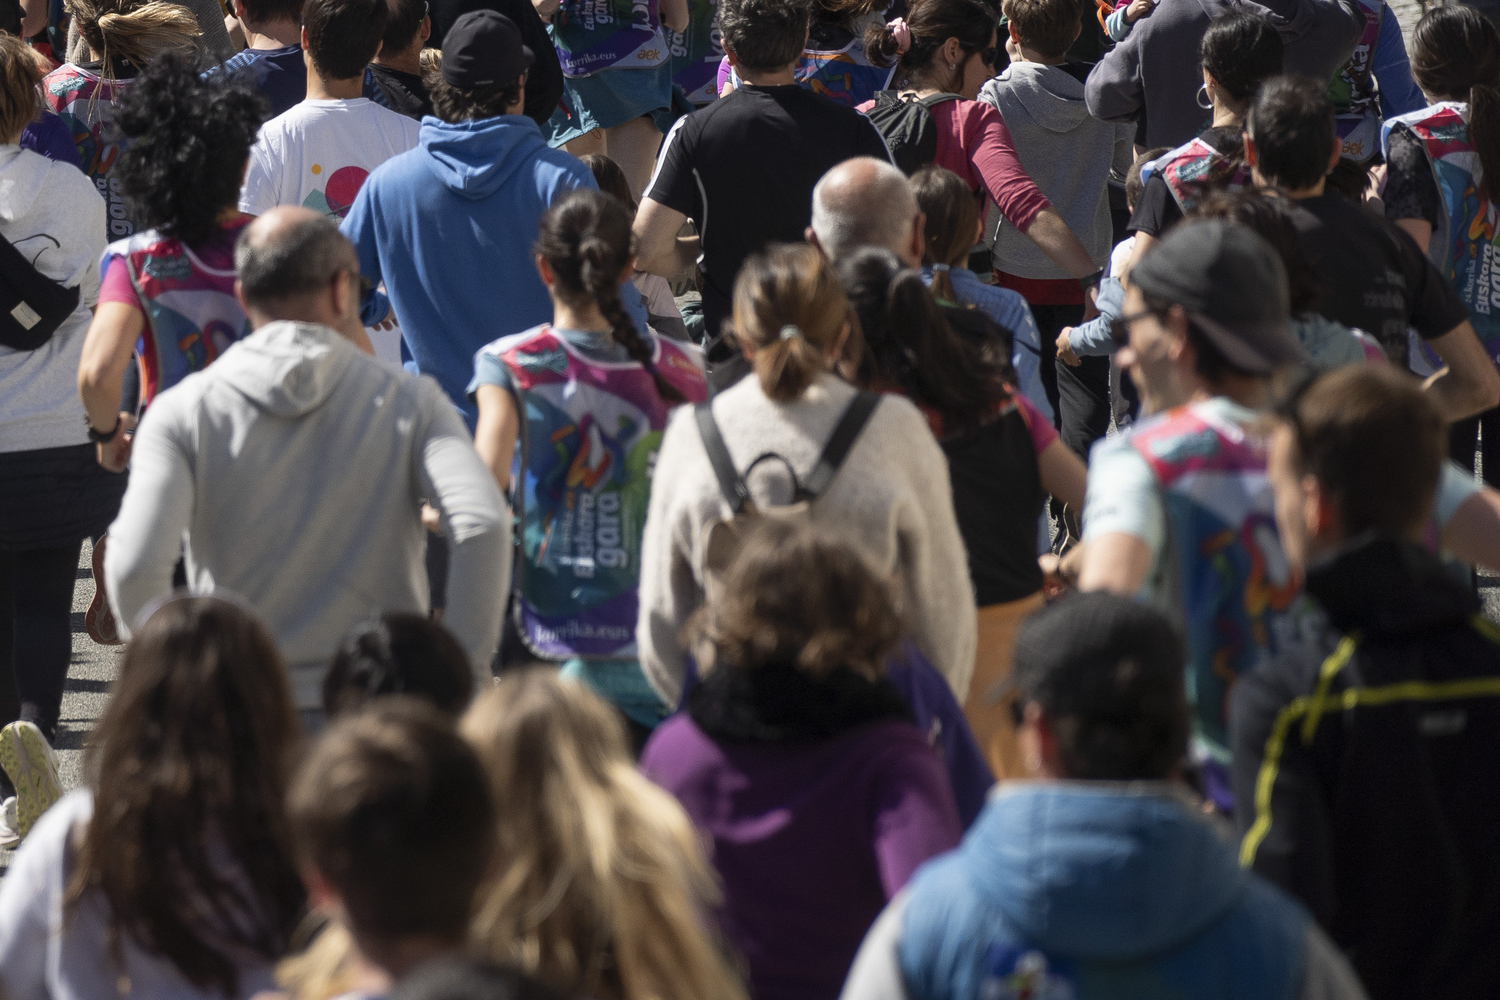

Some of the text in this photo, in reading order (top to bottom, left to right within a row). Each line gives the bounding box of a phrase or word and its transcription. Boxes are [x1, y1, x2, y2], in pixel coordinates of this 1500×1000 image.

[566, 51, 617, 69] korrika.eus
[637, 49, 661, 61] aek
[1475, 244, 1493, 316] Euskara
[597, 492, 628, 567] gara
